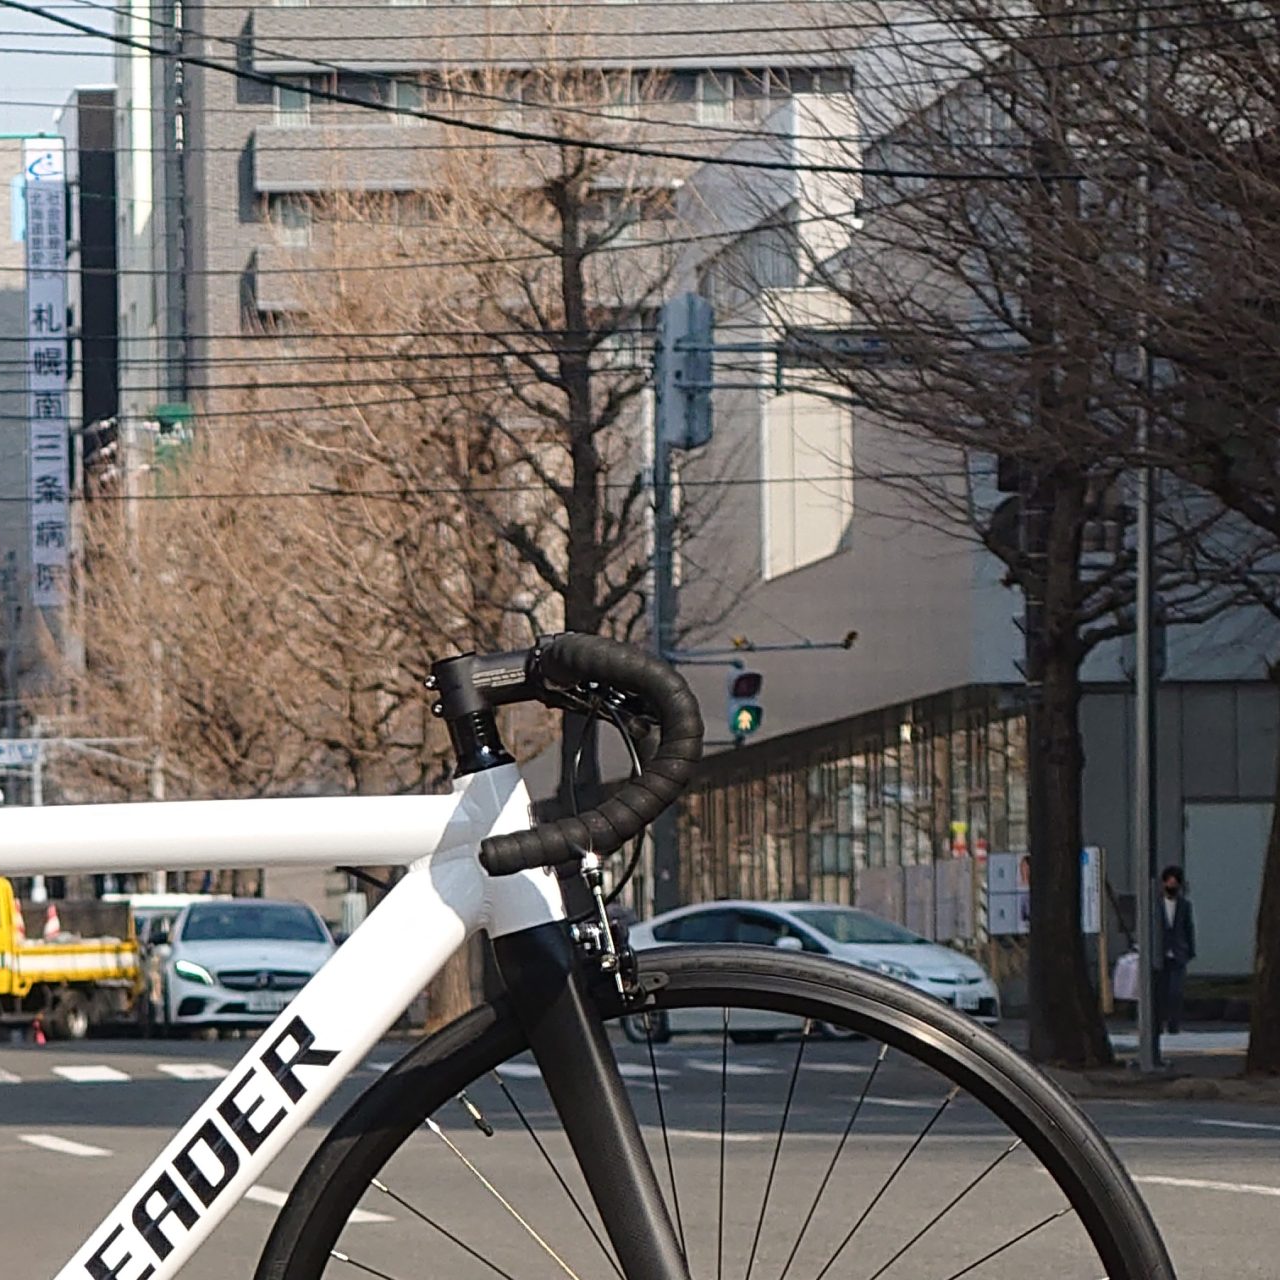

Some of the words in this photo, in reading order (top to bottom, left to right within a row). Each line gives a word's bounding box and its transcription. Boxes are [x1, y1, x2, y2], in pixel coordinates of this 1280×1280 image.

[32, 302, 65, 591] 札幌南三条病院
